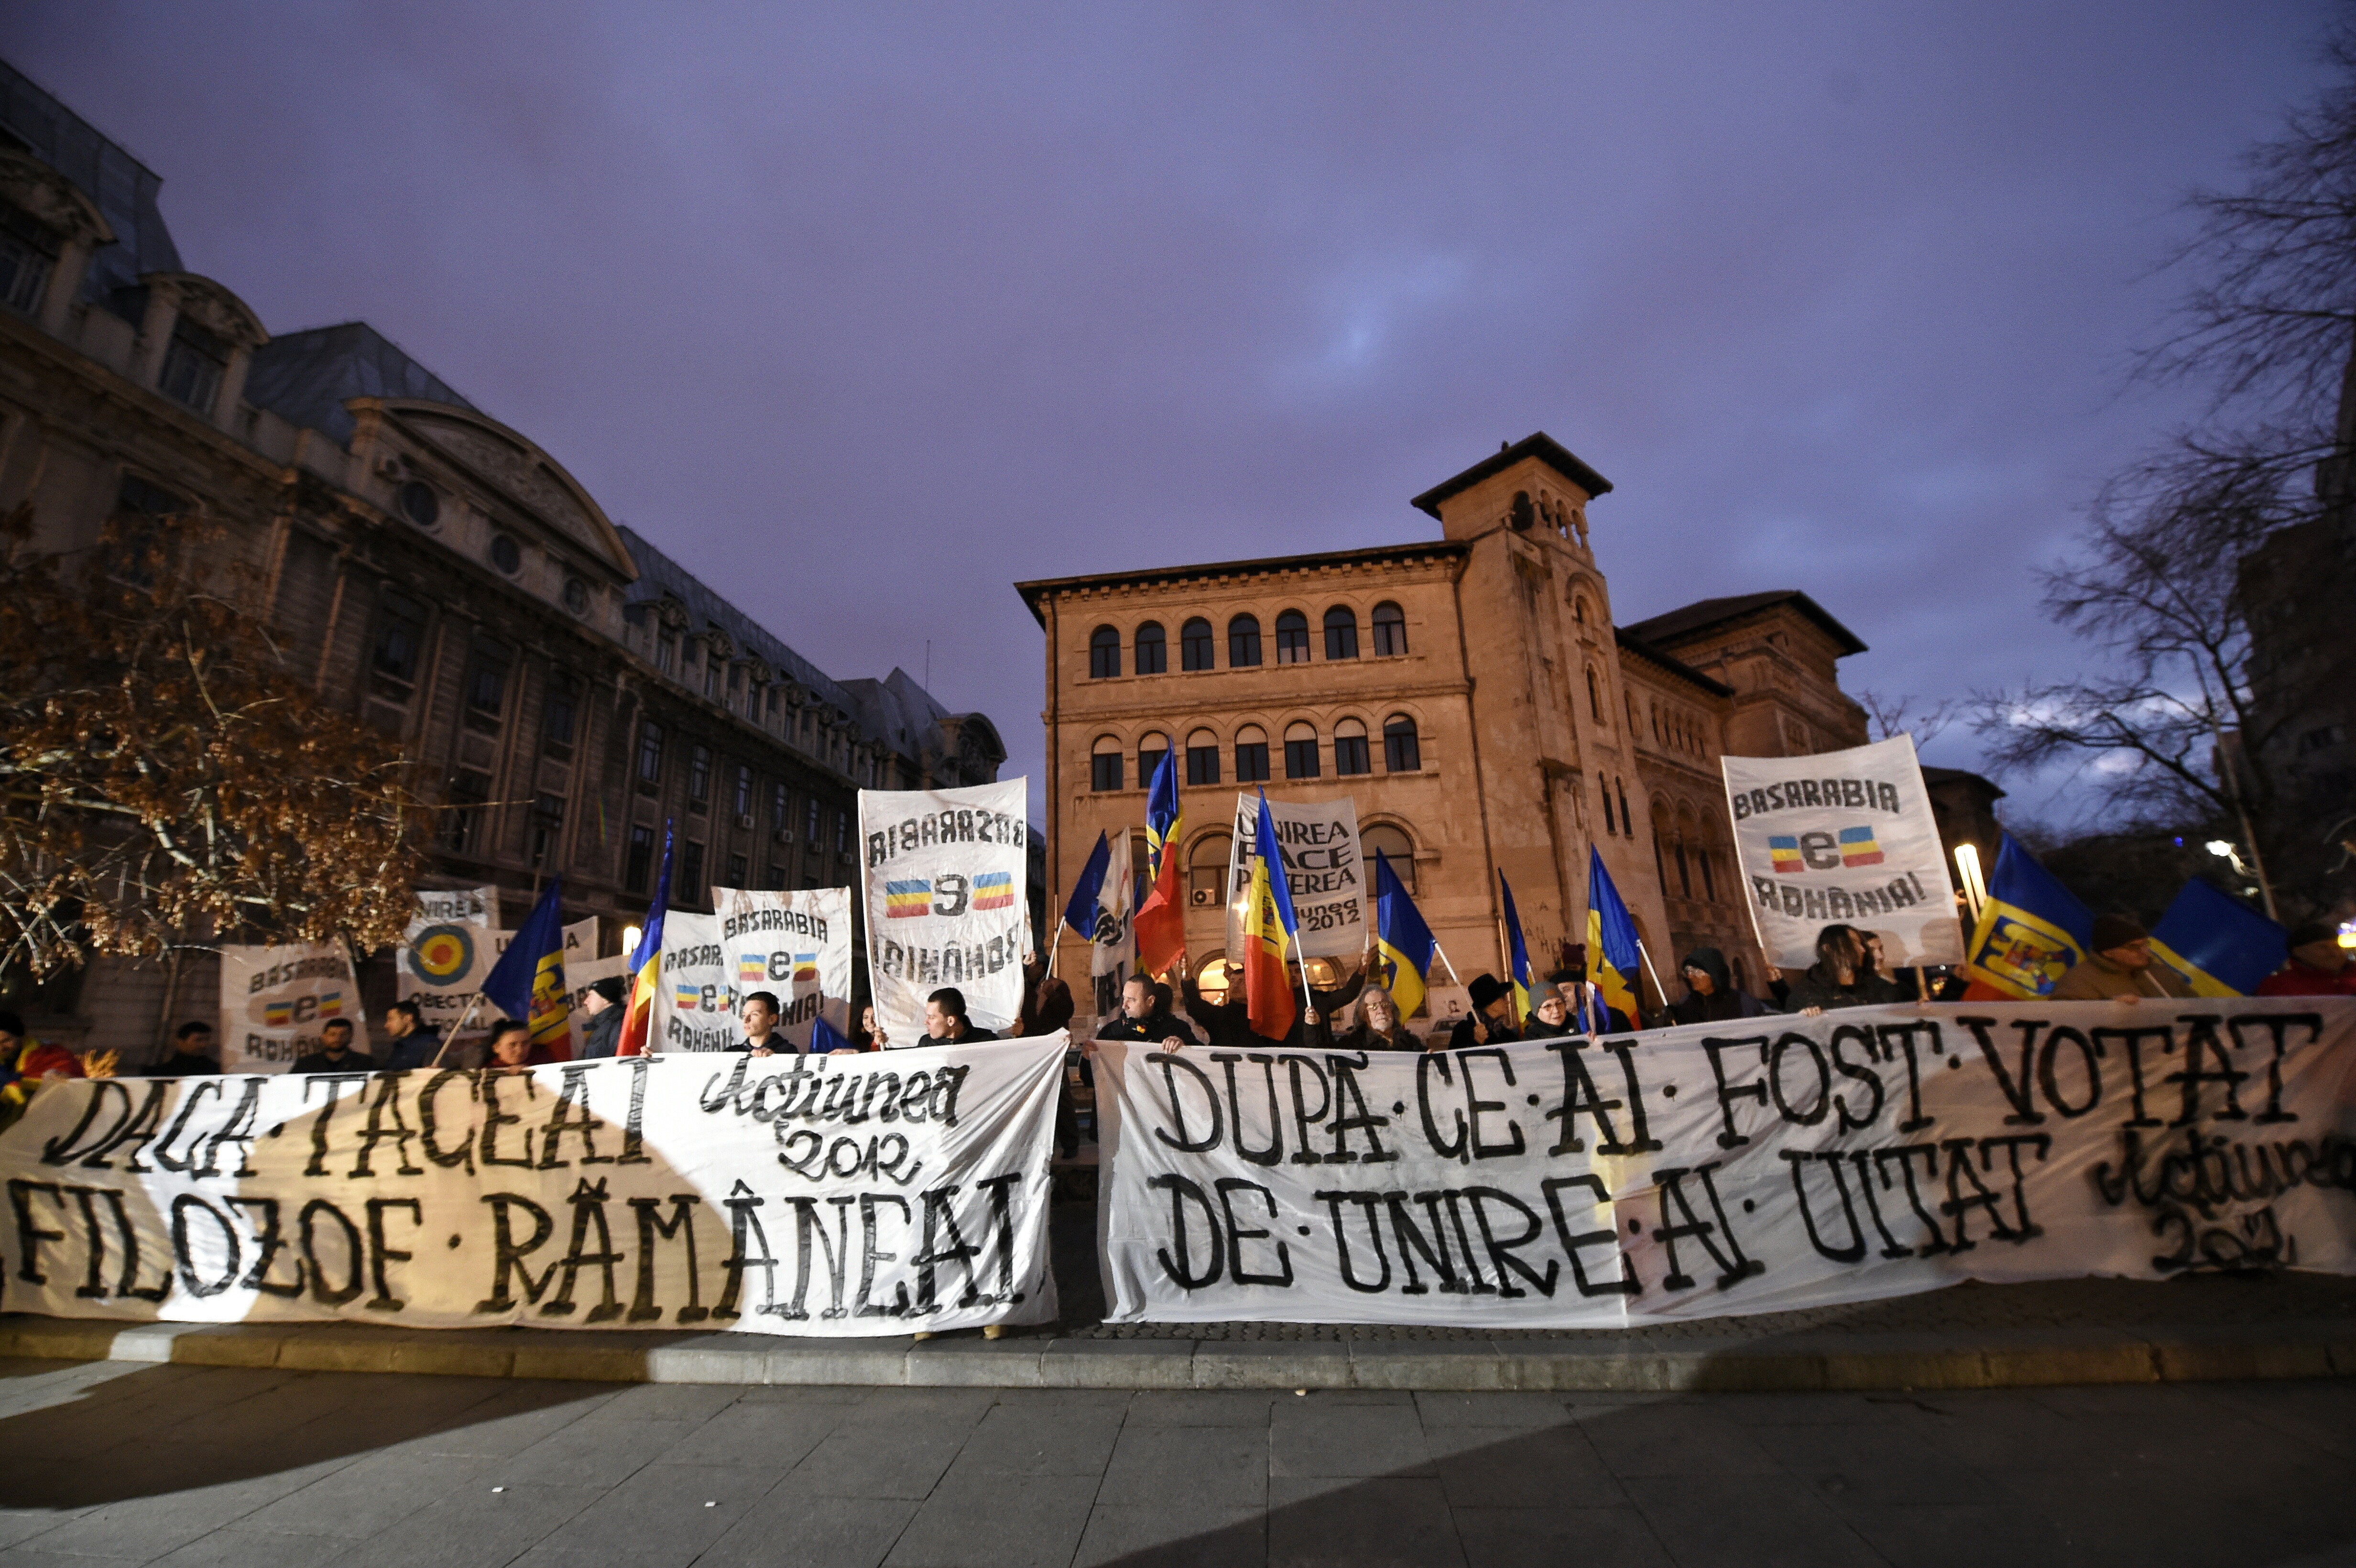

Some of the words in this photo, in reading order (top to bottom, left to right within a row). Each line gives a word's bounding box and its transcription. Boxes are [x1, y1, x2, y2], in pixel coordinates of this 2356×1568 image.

[1734, 779, 1900, 820] BASARABIA
[1801, 832, 1840, 870] e
[1752, 871, 1926, 919] ROMÂNIA!
[724, 909, 828, 943] BASARABIA
[1308, 908, 1361, 932] 2012
[768, 951, 790, 981] e
[295, 995, 317, 1022] e
[701, 984, 717, 1013] e
[1956, 1013, 2324, 1127] VOTAT
[778, 1129, 922, 1186] 2012
[1778, 1132, 2051, 1263] UITAT
[9, 1178, 423, 1311] FILOZOF
[471, 1172, 1025, 1325] RĂMÂNEAI
